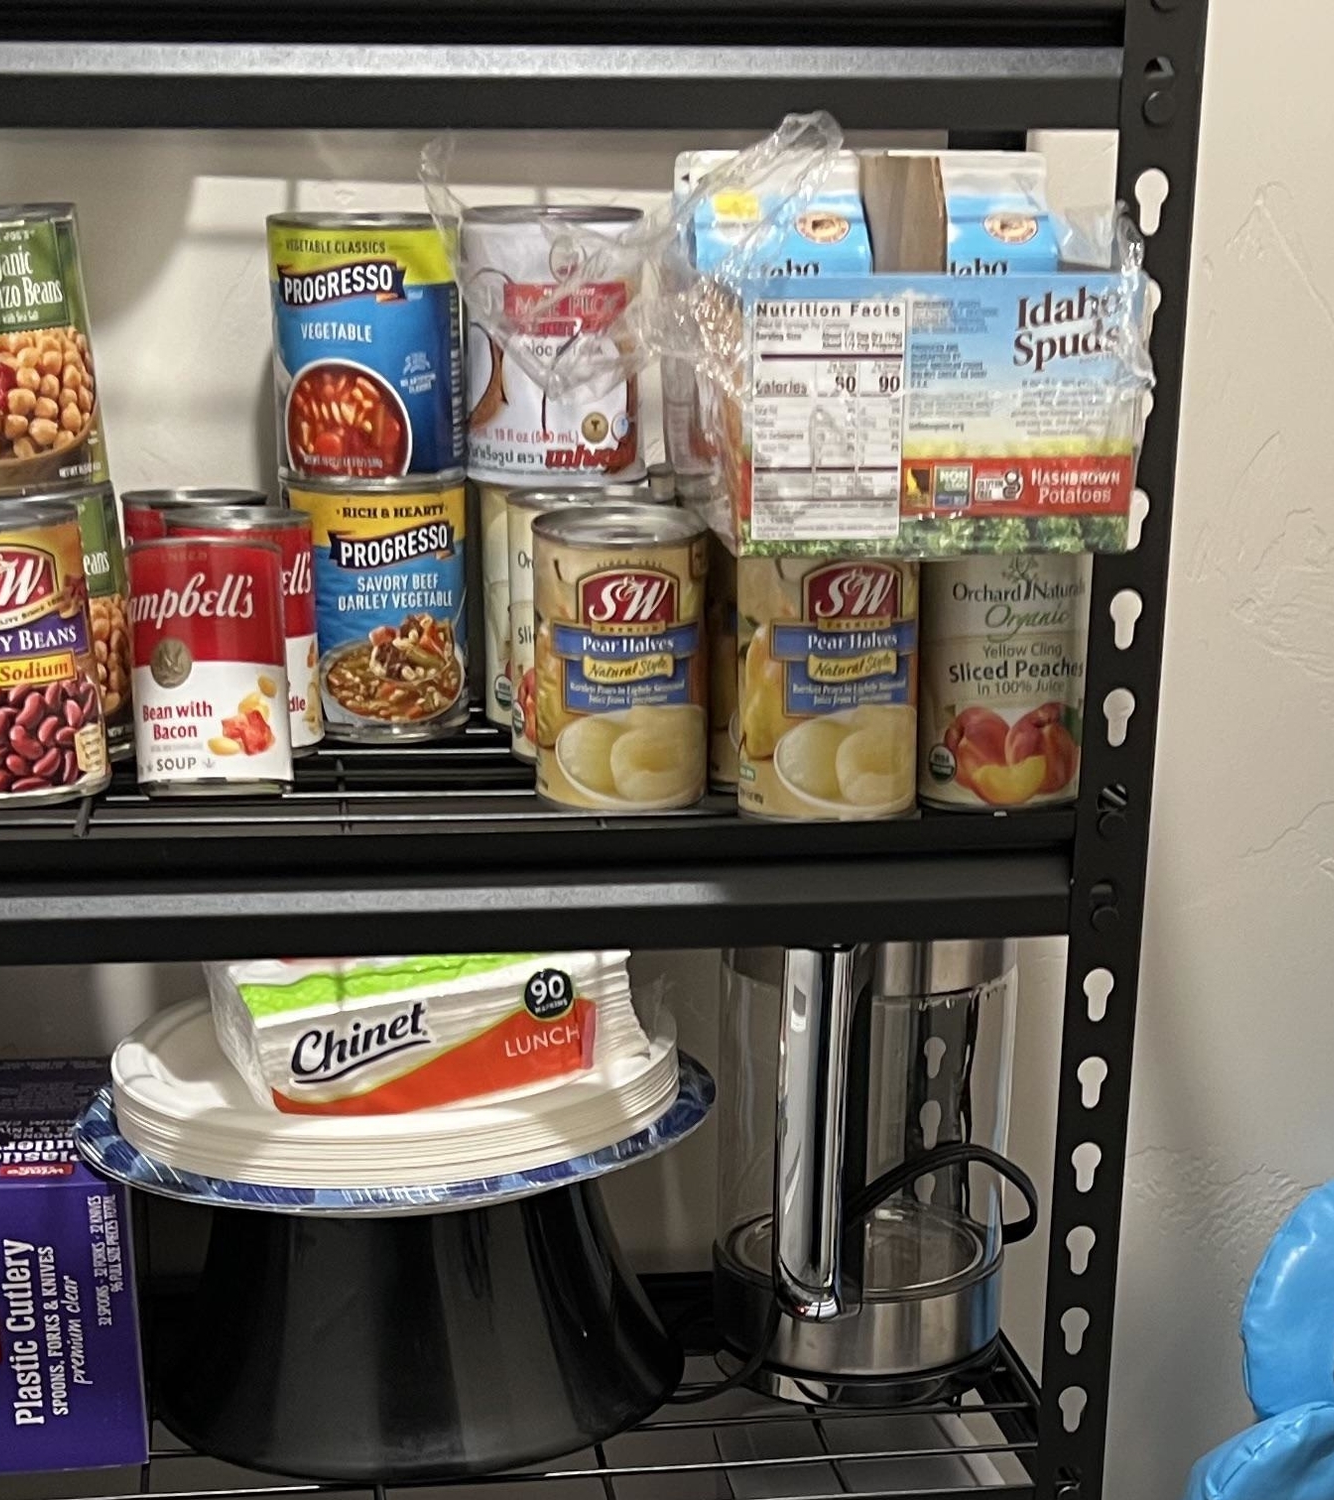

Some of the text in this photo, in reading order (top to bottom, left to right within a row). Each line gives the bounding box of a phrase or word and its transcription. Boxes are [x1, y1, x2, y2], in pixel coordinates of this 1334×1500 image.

[286, 239, 386, 254] VEGETABLE CLASSICS
[22, 276, 63, 306] Beans
[284, 263, 392, 304] PROGRESSO
[756, 303, 901, 318] Nutrition Facts
[1018, 286, 1120, 329] Idaho
[301, 322, 372, 343] VEGETABLE
[1013, 318, 1120, 372] Spuds
[879, 376, 901, 392] 90
[939, 470, 968, 483] NON
[1031, 468, 1120, 487] HASHBROWN
[1038, 486, 1111, 505] Potatoes
[342, 504, 444, 520] RICH & HEARTY
[340, 524, 448, 568] PROGRESSO
[84, 551, 110, 576] eans
[283, 551, 312, 597] ell's
[357, 573, 439, 592] SAVORY BEEF
[952, 581, 1022, 602] Orchard
[129, 571, 254, 630] ampbell's
[338, 591, 453, 612] BARLEY VEGETABLE
[984, 602, 1070, 640] Organic
[19, 623, 77, 651] BEANS
[582, 635, 675, 652] Pear Halves
[807, 632, 898, 650] Pear Halves
[982, 641, 1063, 660] Yellow Cling
[587, 655, 670, 678] Natural Style
[815, 654, 893, 677] Natural Style
[948, 658, 1084, 684] Sliced Peaches
[994, 678, 1066, 694] 100% Juice
[142, 700, 213, 722] Bean with
[153, 721, 198, 741] Bacon
[156, 757, 197, 771] SOUP
[530, 974, 565, 1001] 90
[290, 1001, 430, 1078] Chinet
[504, 1024, 580, 1059] LUNCH
[37, 1245, 58, 1297] KNIVES
[43, 1299, 59, 1310] &
[1, 1239, 45, 1425] Plastic Cutlery
[44, 1313, 63, 1358] FORKS
[61, 1275, 94, 1385] premium clear
